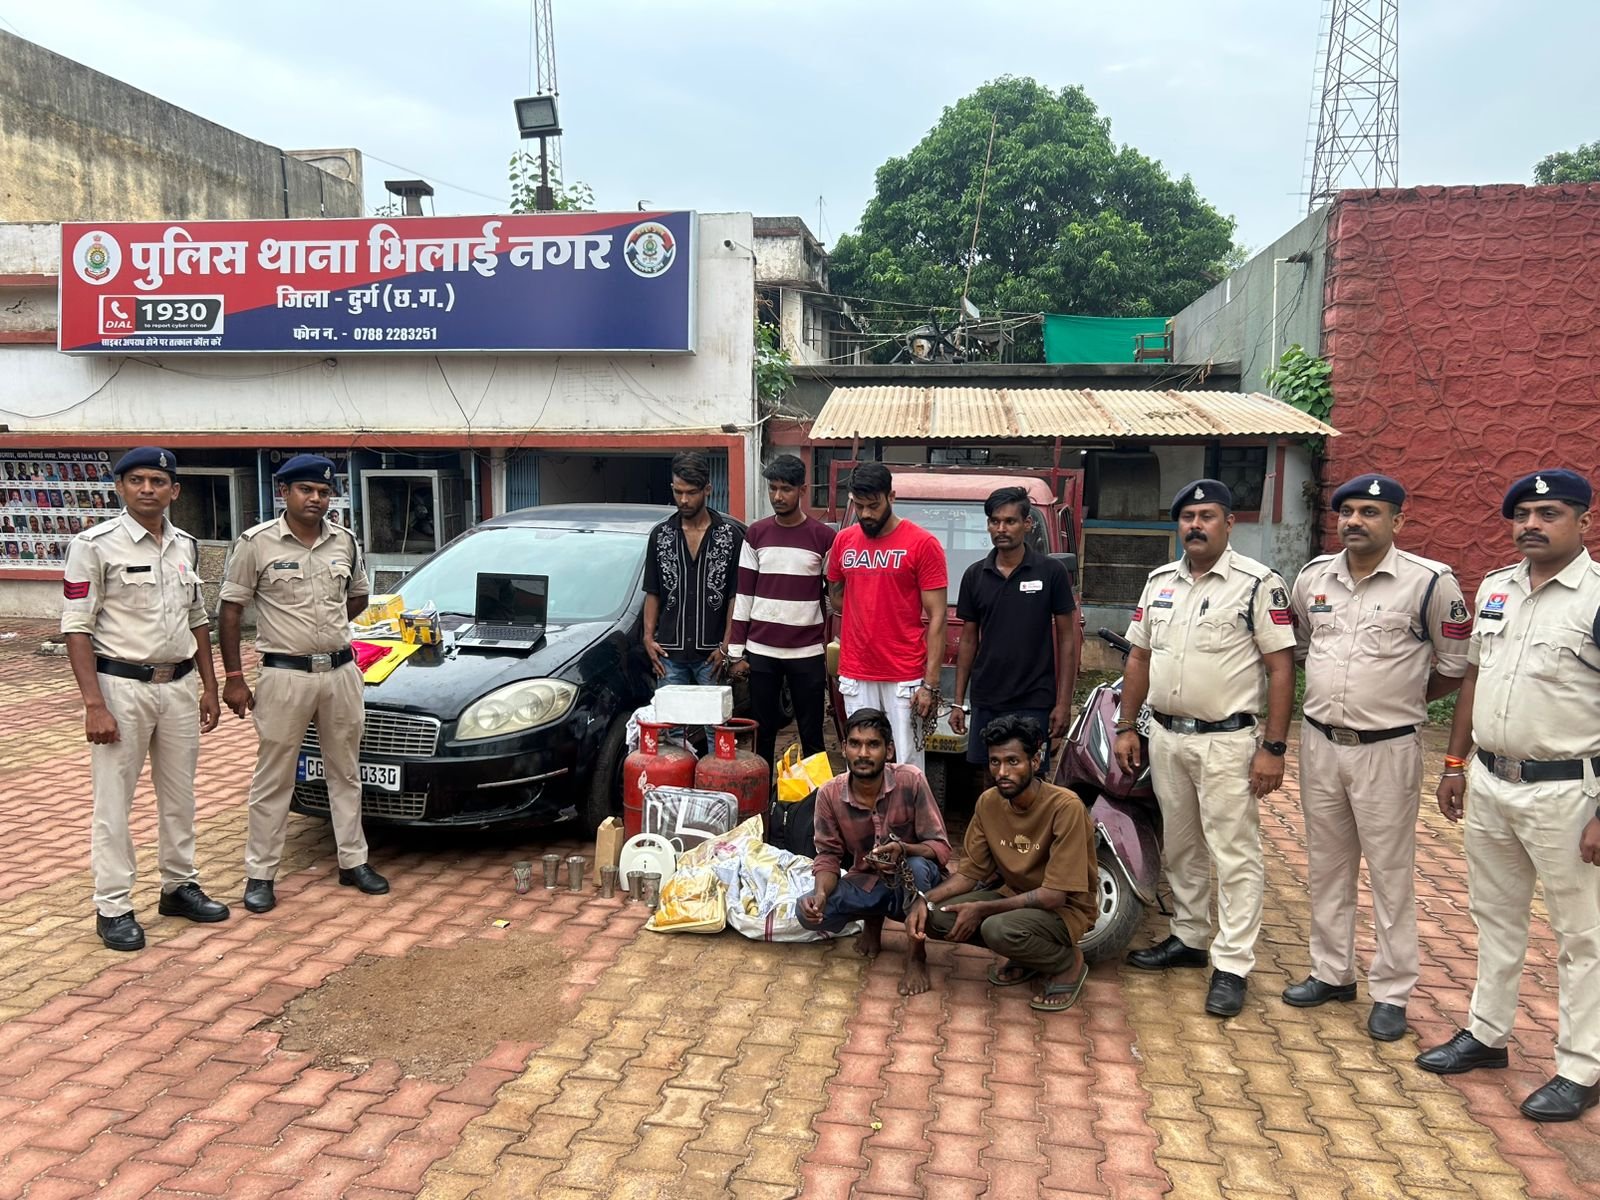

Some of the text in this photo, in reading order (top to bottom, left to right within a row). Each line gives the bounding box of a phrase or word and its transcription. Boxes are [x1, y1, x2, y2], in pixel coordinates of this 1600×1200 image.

[130, 221, 613, 290] पुलिस थाना भिलाई नगर
[276, 285, 330, 308] जिला
[142, 303, 207, 321] 1930
[101, 336, 222, 347] साइबर अपराध होने पर तत्काल कॉल करें
[293, 325, 320, 340] फोन
[354, 328, 383, 340] 0788
[386, 327, 437, 341] 2283251
[842, 549, 908, 569] GANT
[307, 760, 397, 785] CG 0330
